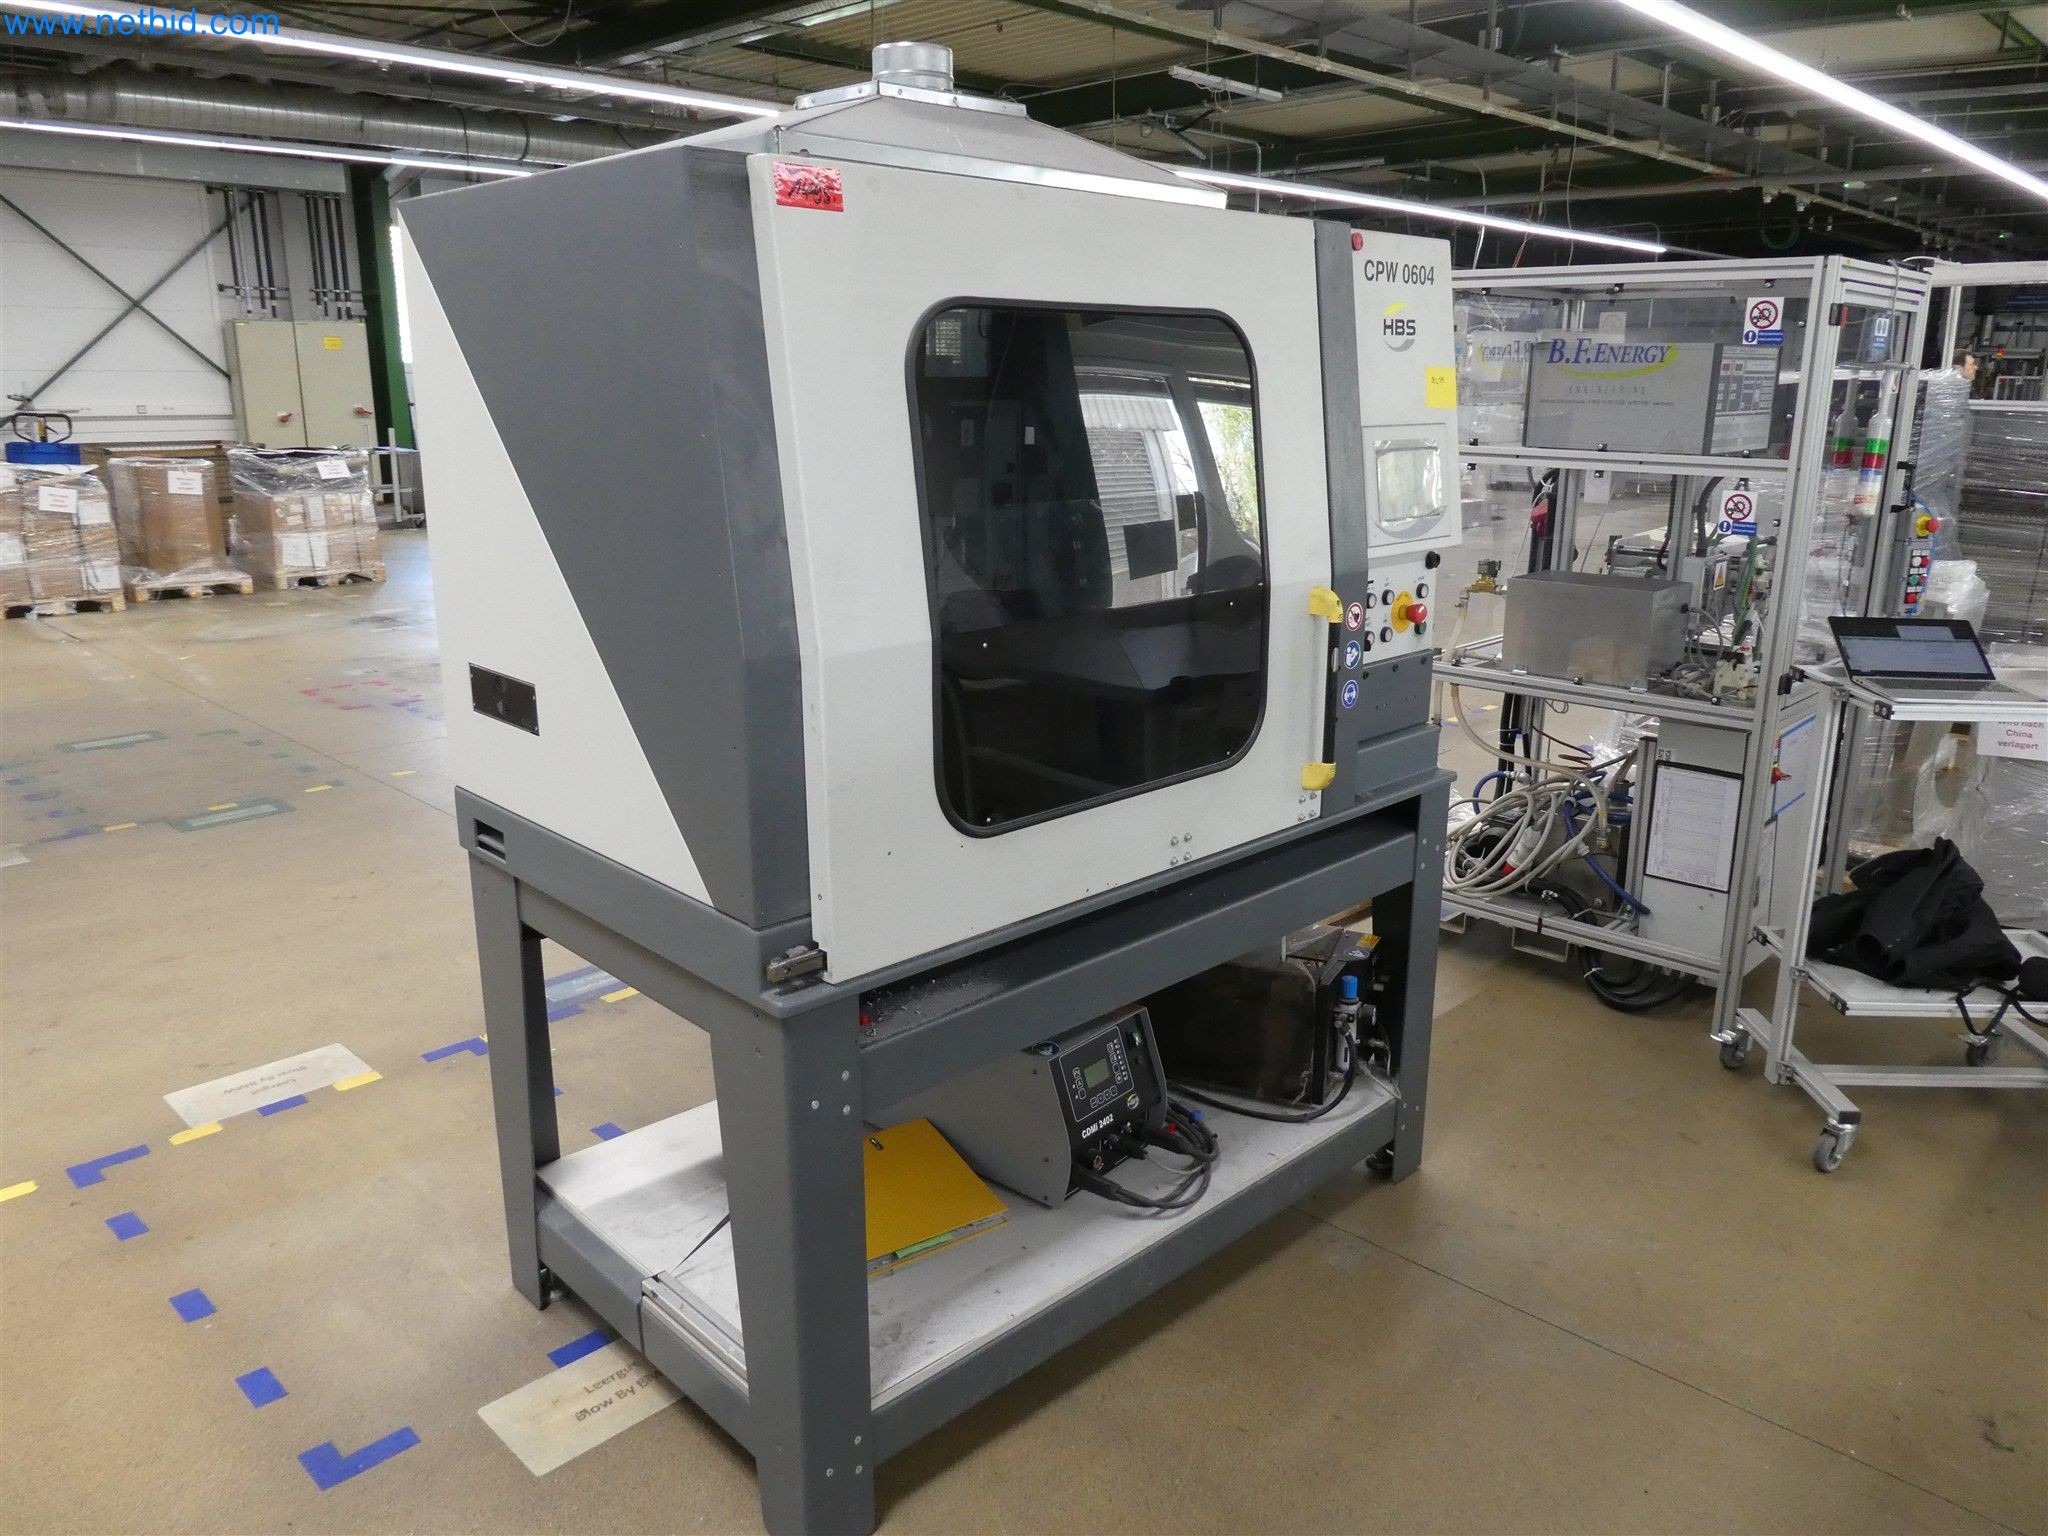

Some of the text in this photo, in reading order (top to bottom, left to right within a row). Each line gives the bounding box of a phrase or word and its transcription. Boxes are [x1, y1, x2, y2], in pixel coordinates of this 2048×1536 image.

[1364, 259, 1435, 286] CPW 0604
[1383, 318, 1416, 336] HBS
[2005, 729, 2034, 738] China
[1998, 740, 2040, 750] verlagert
[1081, 1113, 1114, 1139] CDMi 2402
[574, 1385, 637, 1422] Blow By
